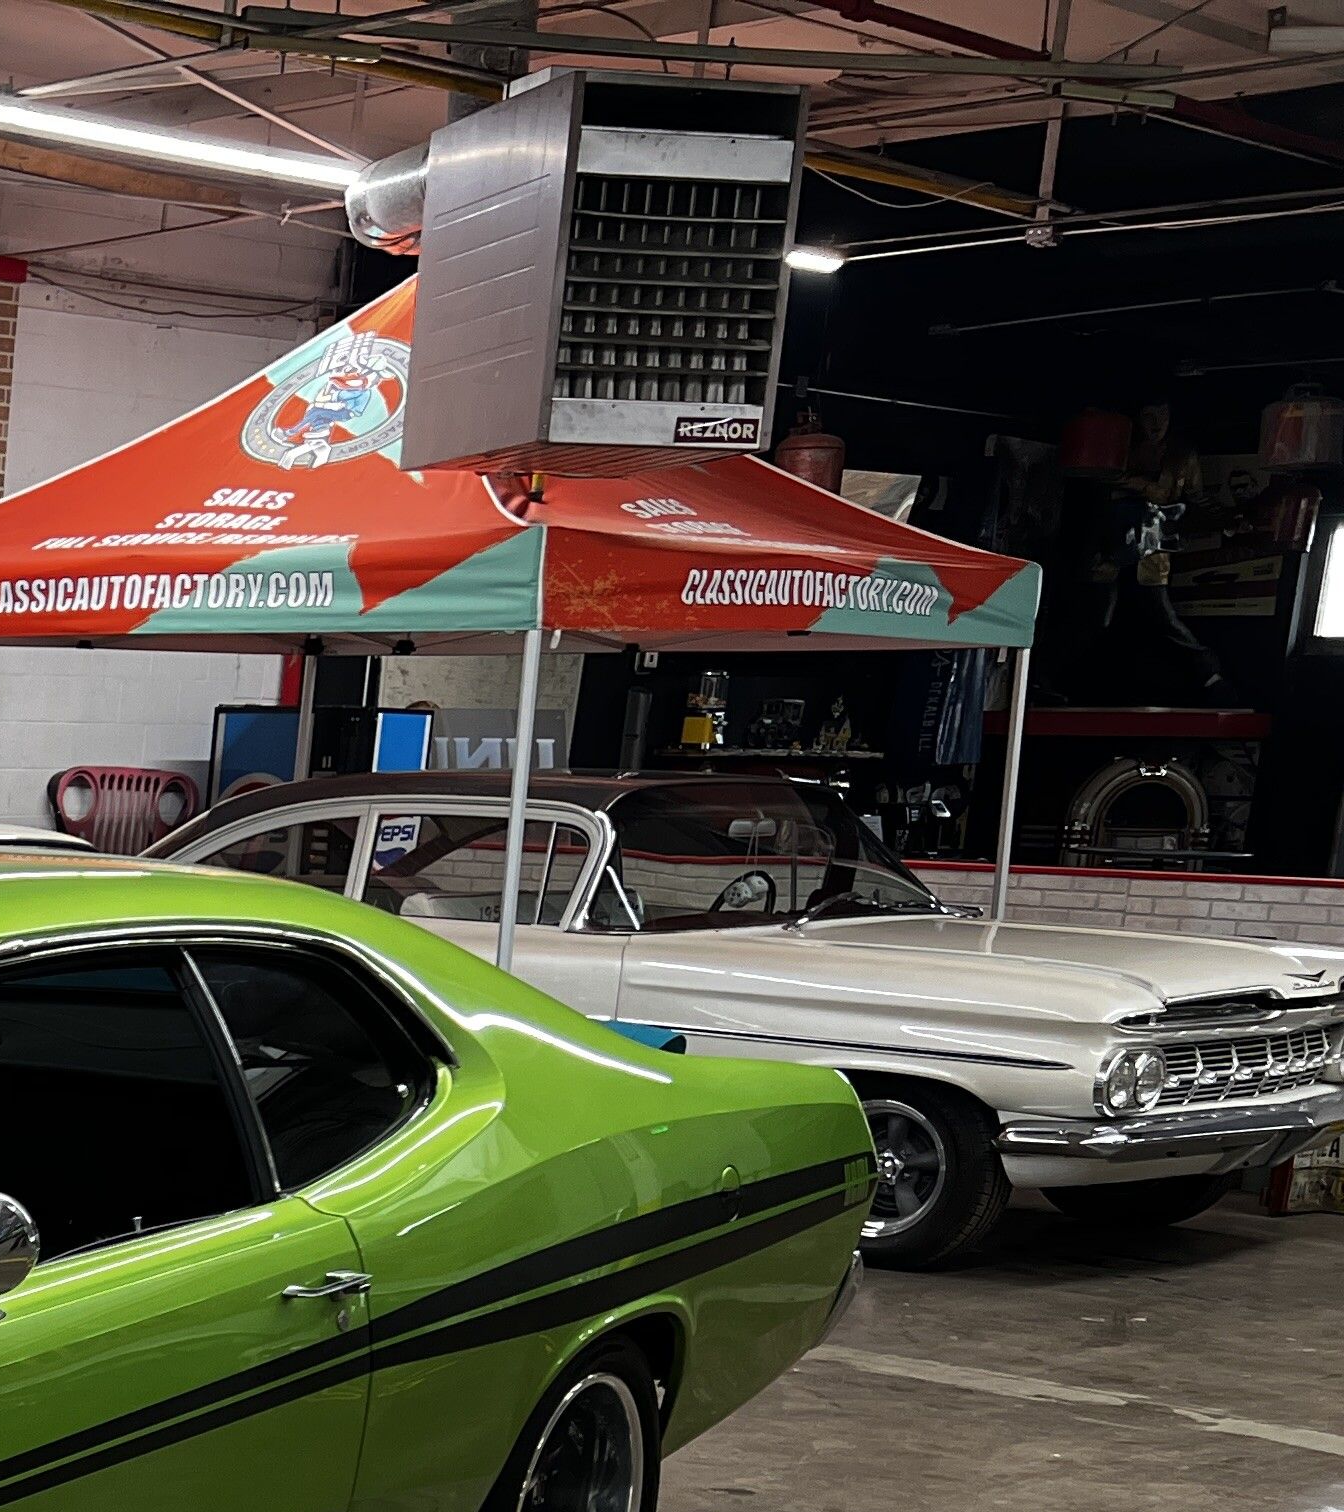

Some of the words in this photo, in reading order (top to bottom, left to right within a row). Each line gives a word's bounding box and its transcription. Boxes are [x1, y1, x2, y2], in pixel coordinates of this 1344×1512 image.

[678, 421, 756, 441] REZNOR
[204, 488, 295, 510] SALES
[155, 512, 288, 531] STORAGE
[680, 568, 940, 617] CLASSICAUTOFACTORY.COM
[378, 824, 417, 842] EPSI
